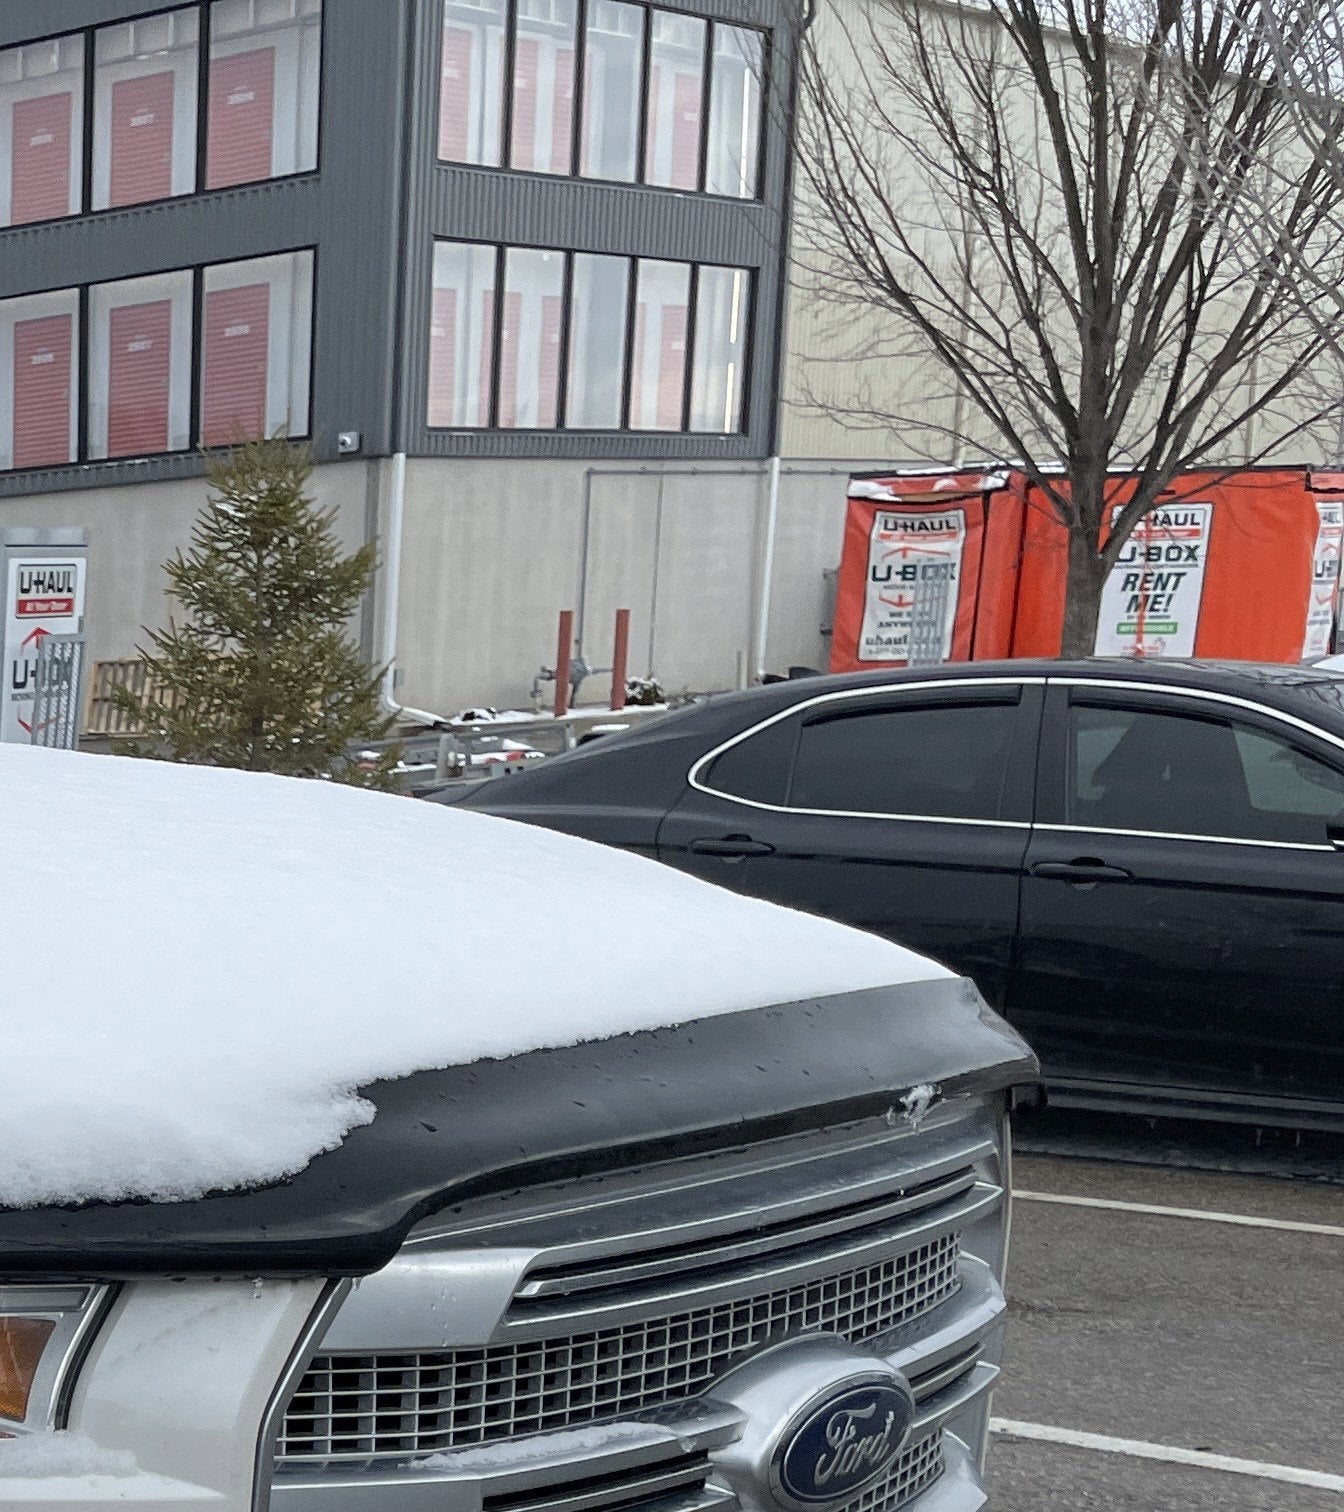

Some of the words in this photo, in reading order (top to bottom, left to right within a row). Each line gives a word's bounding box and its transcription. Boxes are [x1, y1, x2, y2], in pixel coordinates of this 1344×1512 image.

[883, 519, 956, 532] U-HAUL
[20, 571, 74, 594] U-HAUL
[1120, 571, 1188, 592] RENT
[1125, 593, 1175, 613] ME!
[814, 1402, 896, 1486] Ford
